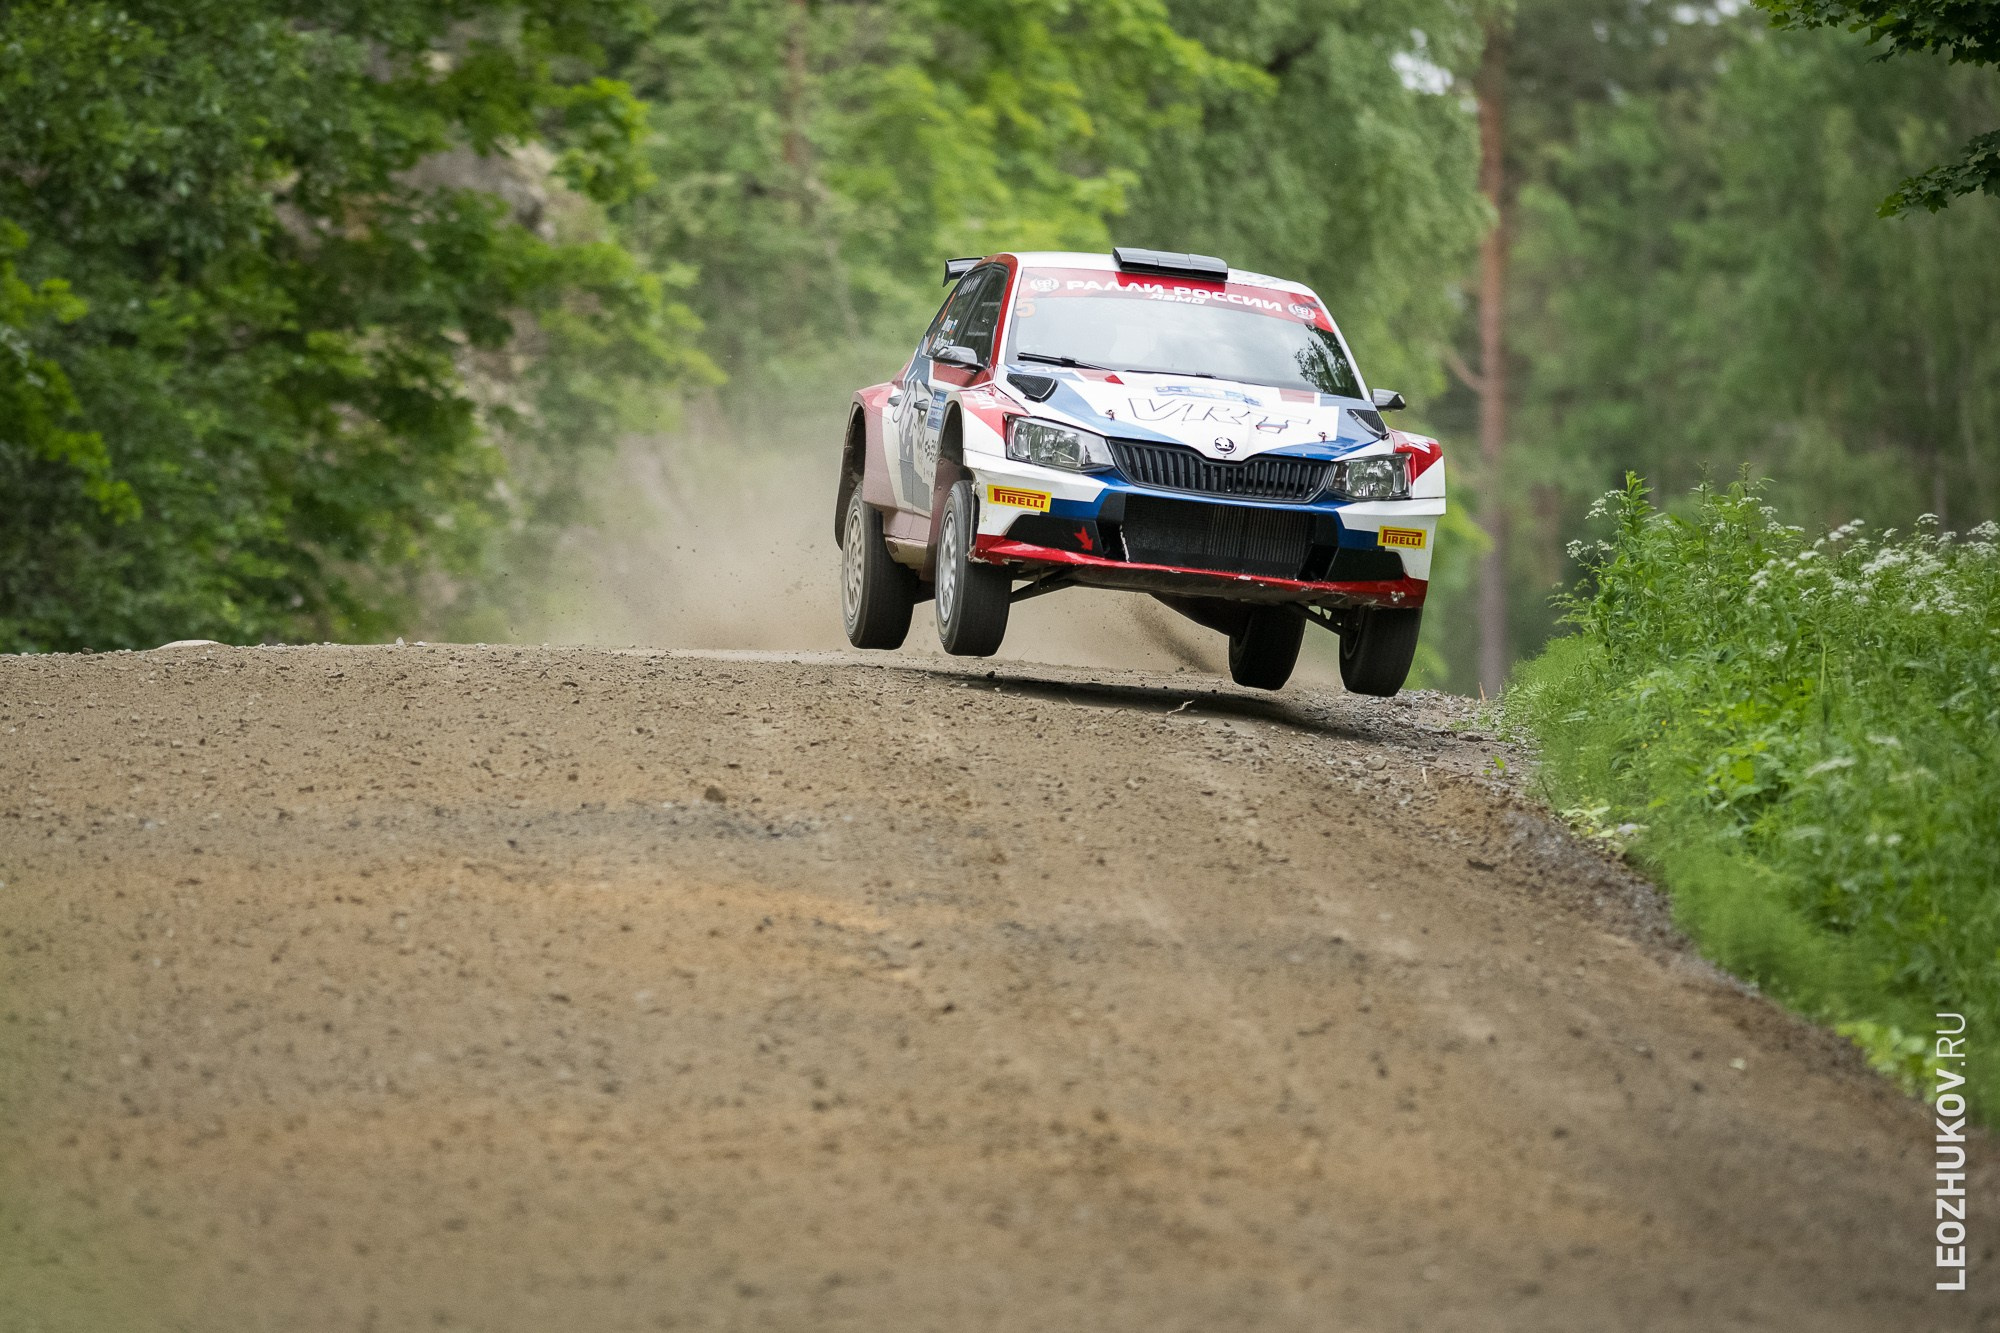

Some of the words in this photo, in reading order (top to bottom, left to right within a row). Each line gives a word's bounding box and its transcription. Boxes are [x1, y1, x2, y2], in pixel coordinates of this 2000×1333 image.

[1067, 280, 1165, 295] РАЛЛИ
[1174, 286, 1282, 312] РОССИИ
[1016, 298, 1036, 318] 5
[1128, 397, 1311, 434] VRT
[994, 488, 1046, 508] PIRELLI
[1383, 529, 1423, 546] PIRELLI
